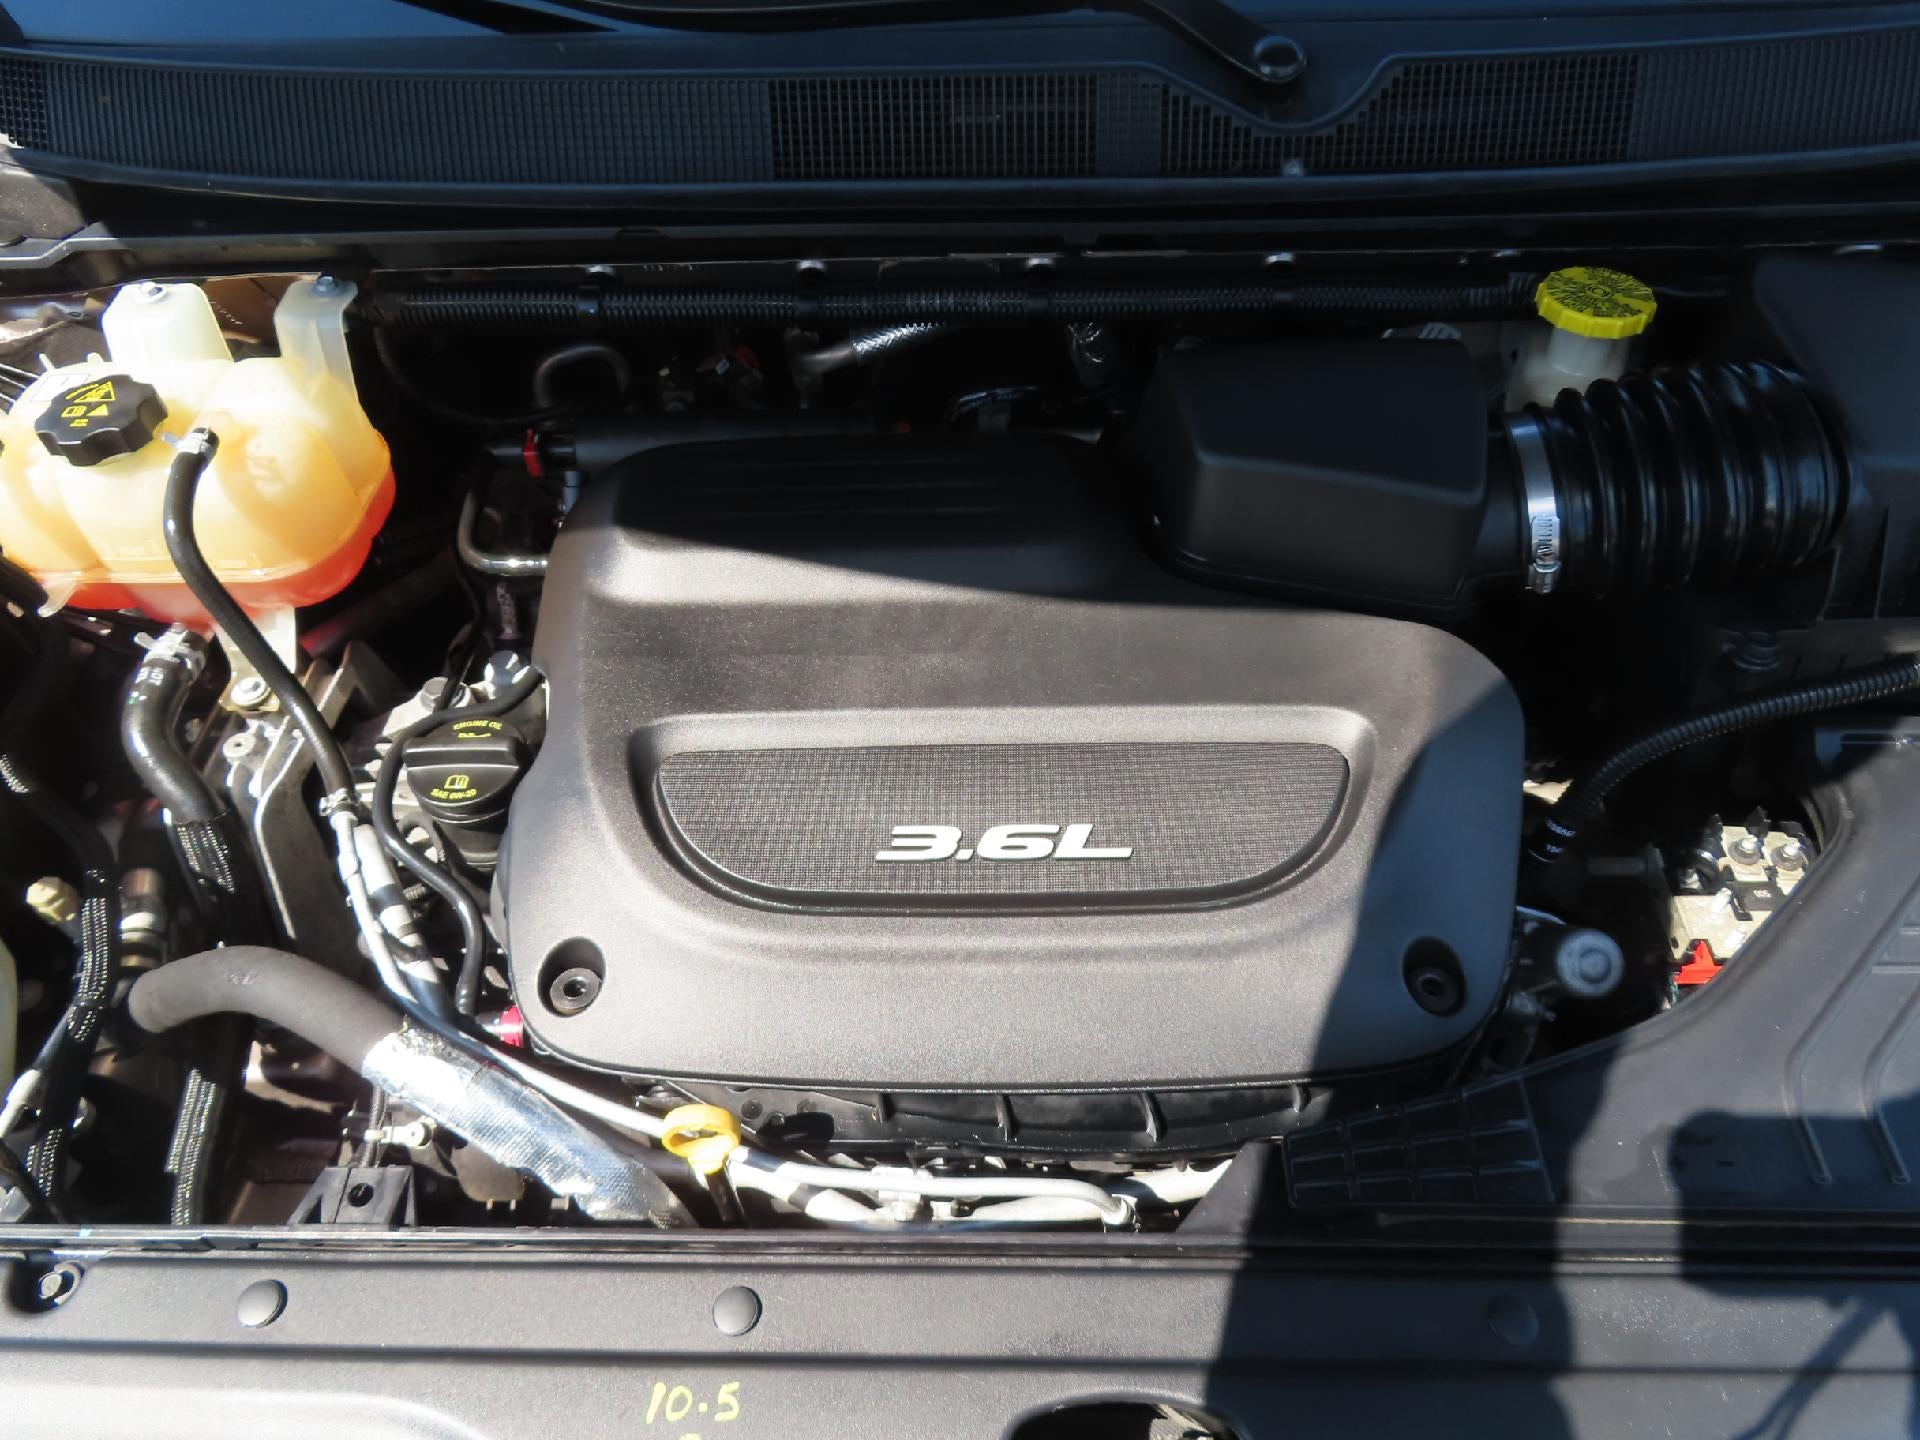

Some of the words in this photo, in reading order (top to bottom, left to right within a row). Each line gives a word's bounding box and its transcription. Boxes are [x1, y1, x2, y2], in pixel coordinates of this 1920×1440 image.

[453, 720, 488, 730] ENGINE
[488, 721, 502, 730] OIL
[430, 788, 448, 799] SAE
[875, 824, 1133, 862] 3.6L
[646, 1382, 740, 1424] 10.5
